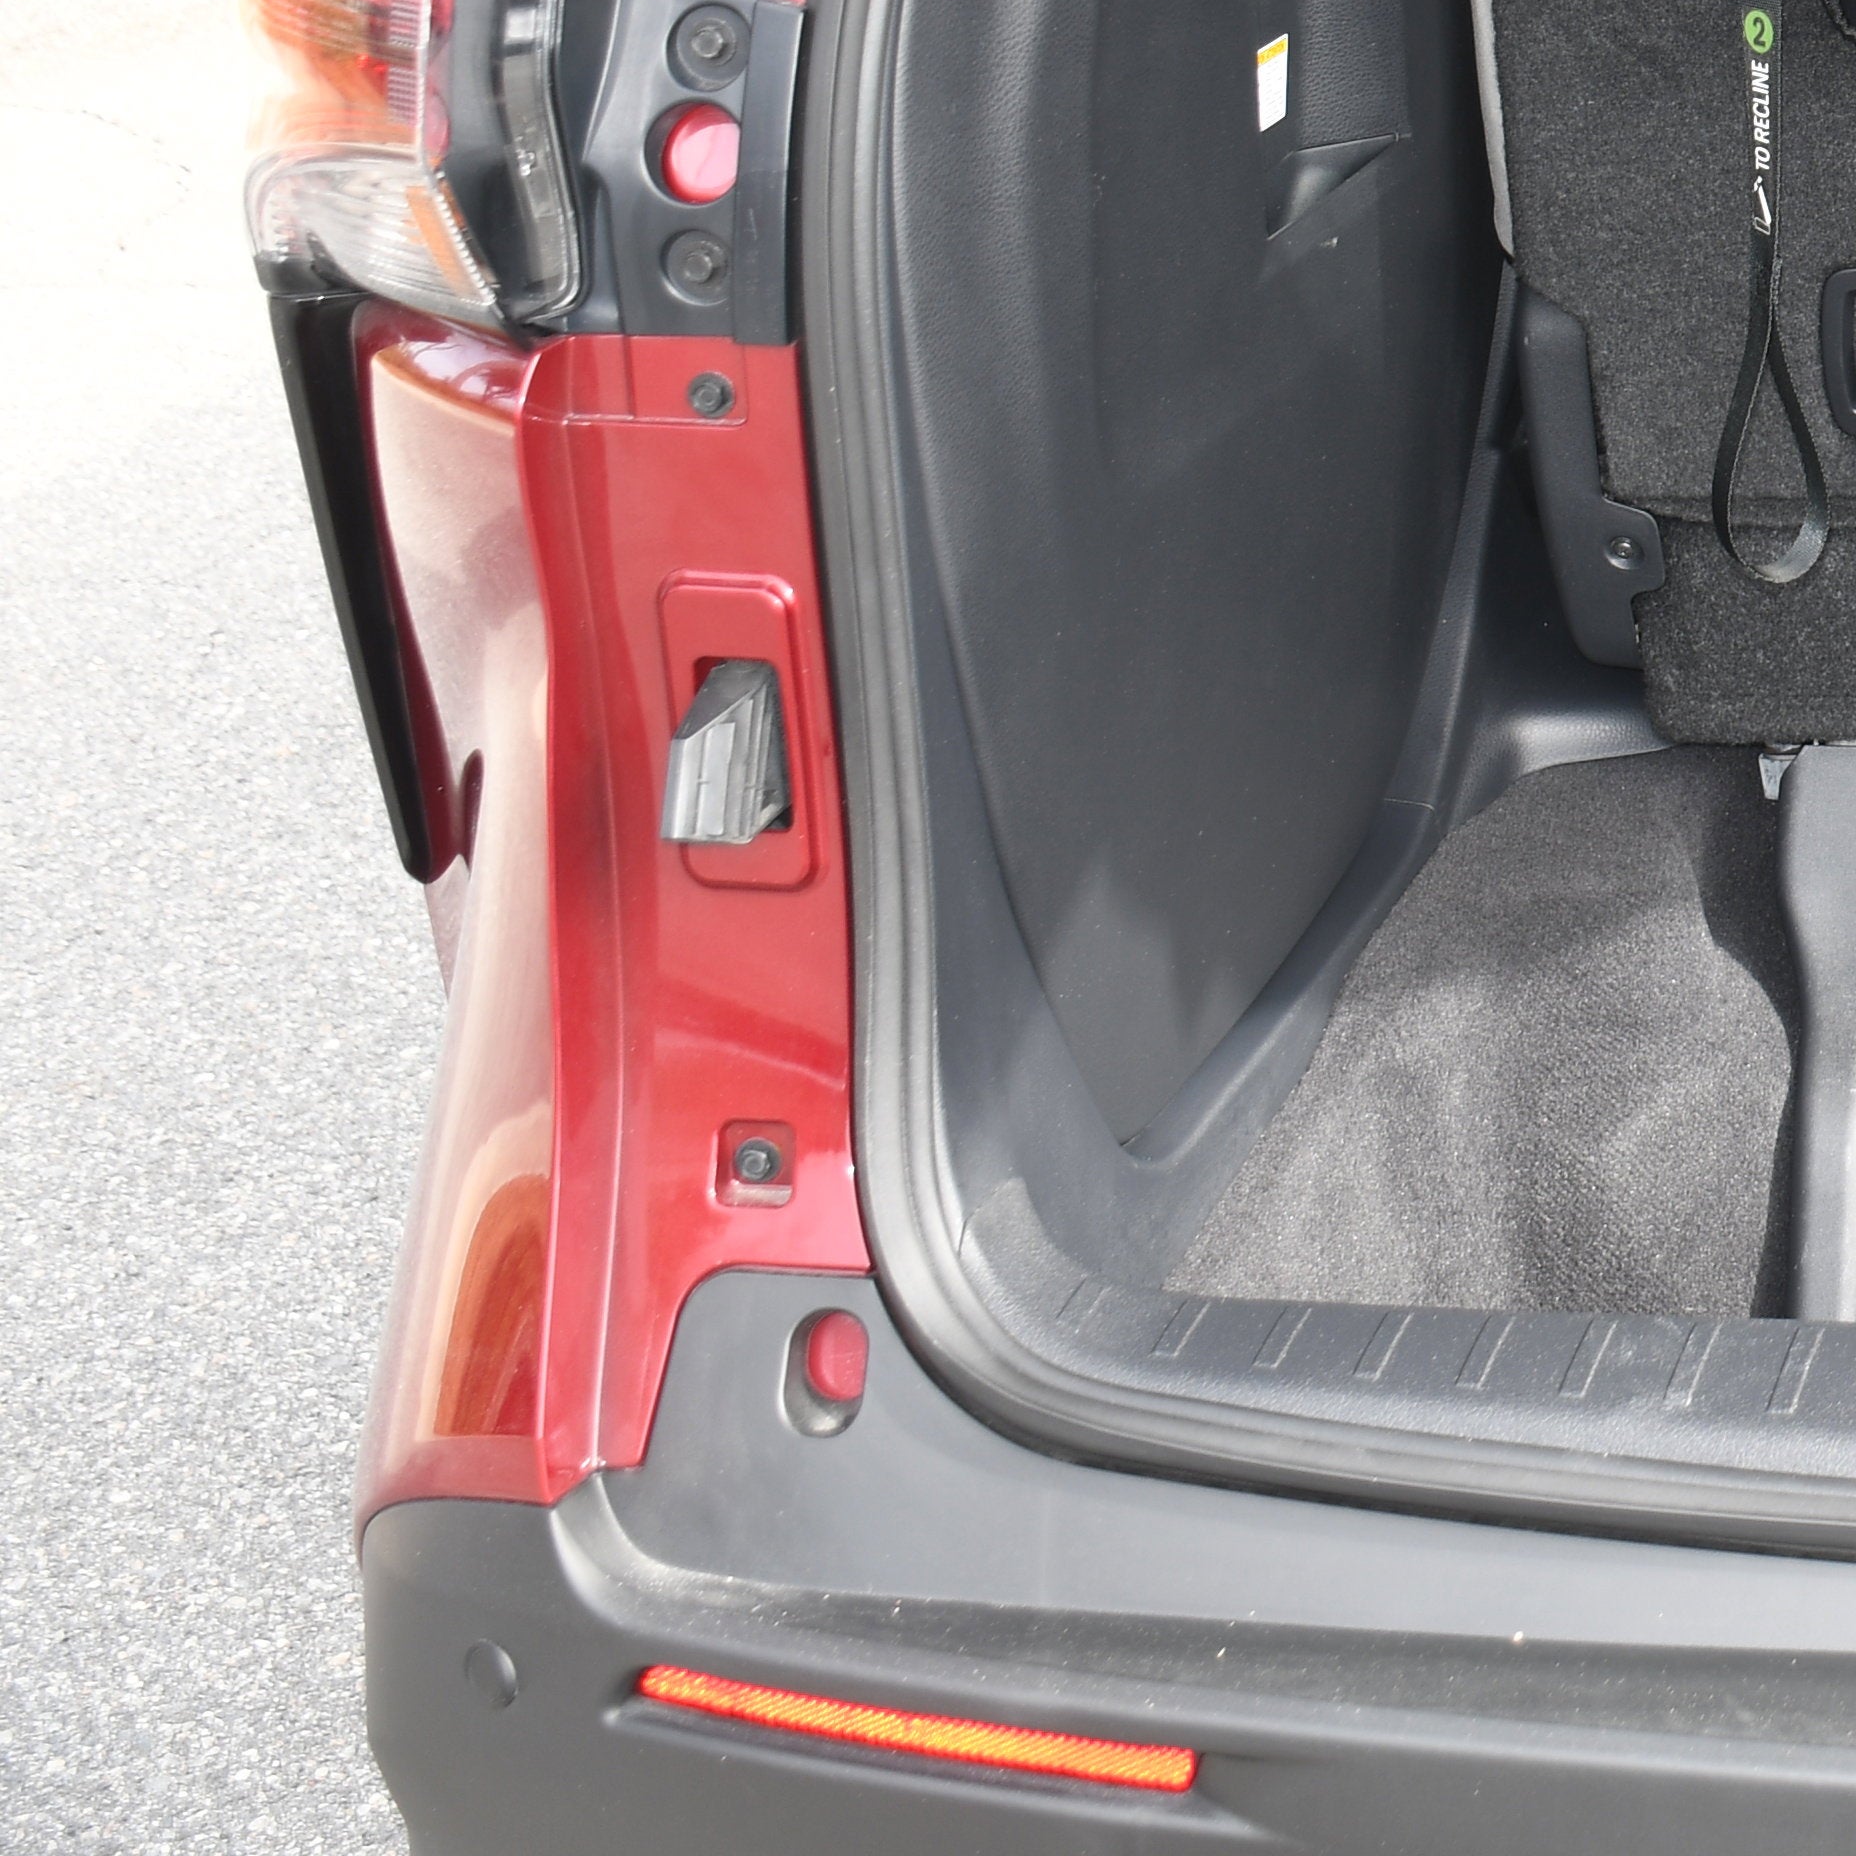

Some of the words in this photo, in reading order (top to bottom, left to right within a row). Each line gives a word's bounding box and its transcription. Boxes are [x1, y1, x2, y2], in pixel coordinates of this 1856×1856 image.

[1752, 17, 1767, 47] 2
[1751, 59, 1771, 144] RECLINE
[1754, 147, 1771, 170] TO
